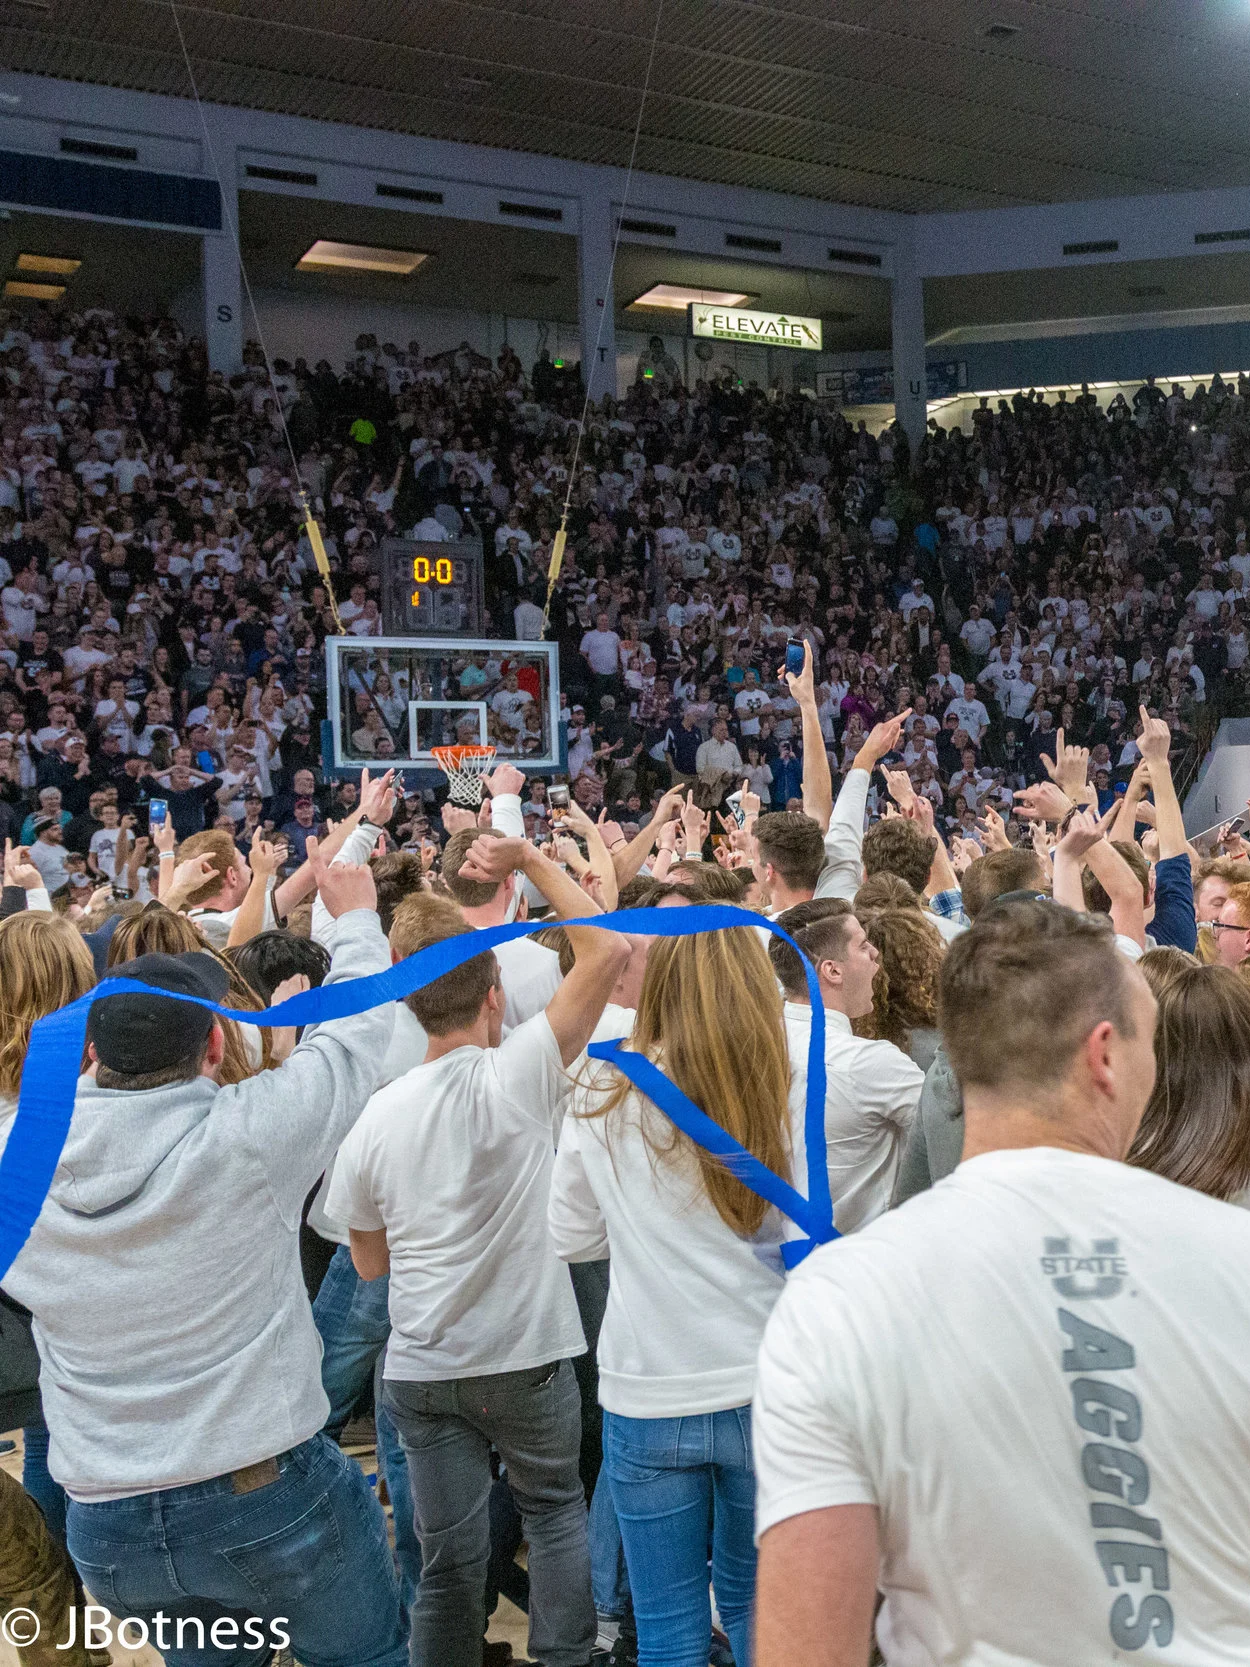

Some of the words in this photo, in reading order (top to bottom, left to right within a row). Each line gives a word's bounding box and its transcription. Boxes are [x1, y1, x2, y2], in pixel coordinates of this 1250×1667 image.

[217, 305, 232, 322] S
[713, 314, 801, 338] ELEVATE
[714, 329, 742, 339] PEST
[747, 333, 800, 345] CONTROL
[597, 346, 608, 361] T
[909, 380, 920, 394] U
[413, 556, 452, 584] 0.0
[1040, 1256, 1129, 1276] STATE
[1057, 1307, 1174, 1651] AGGIES
